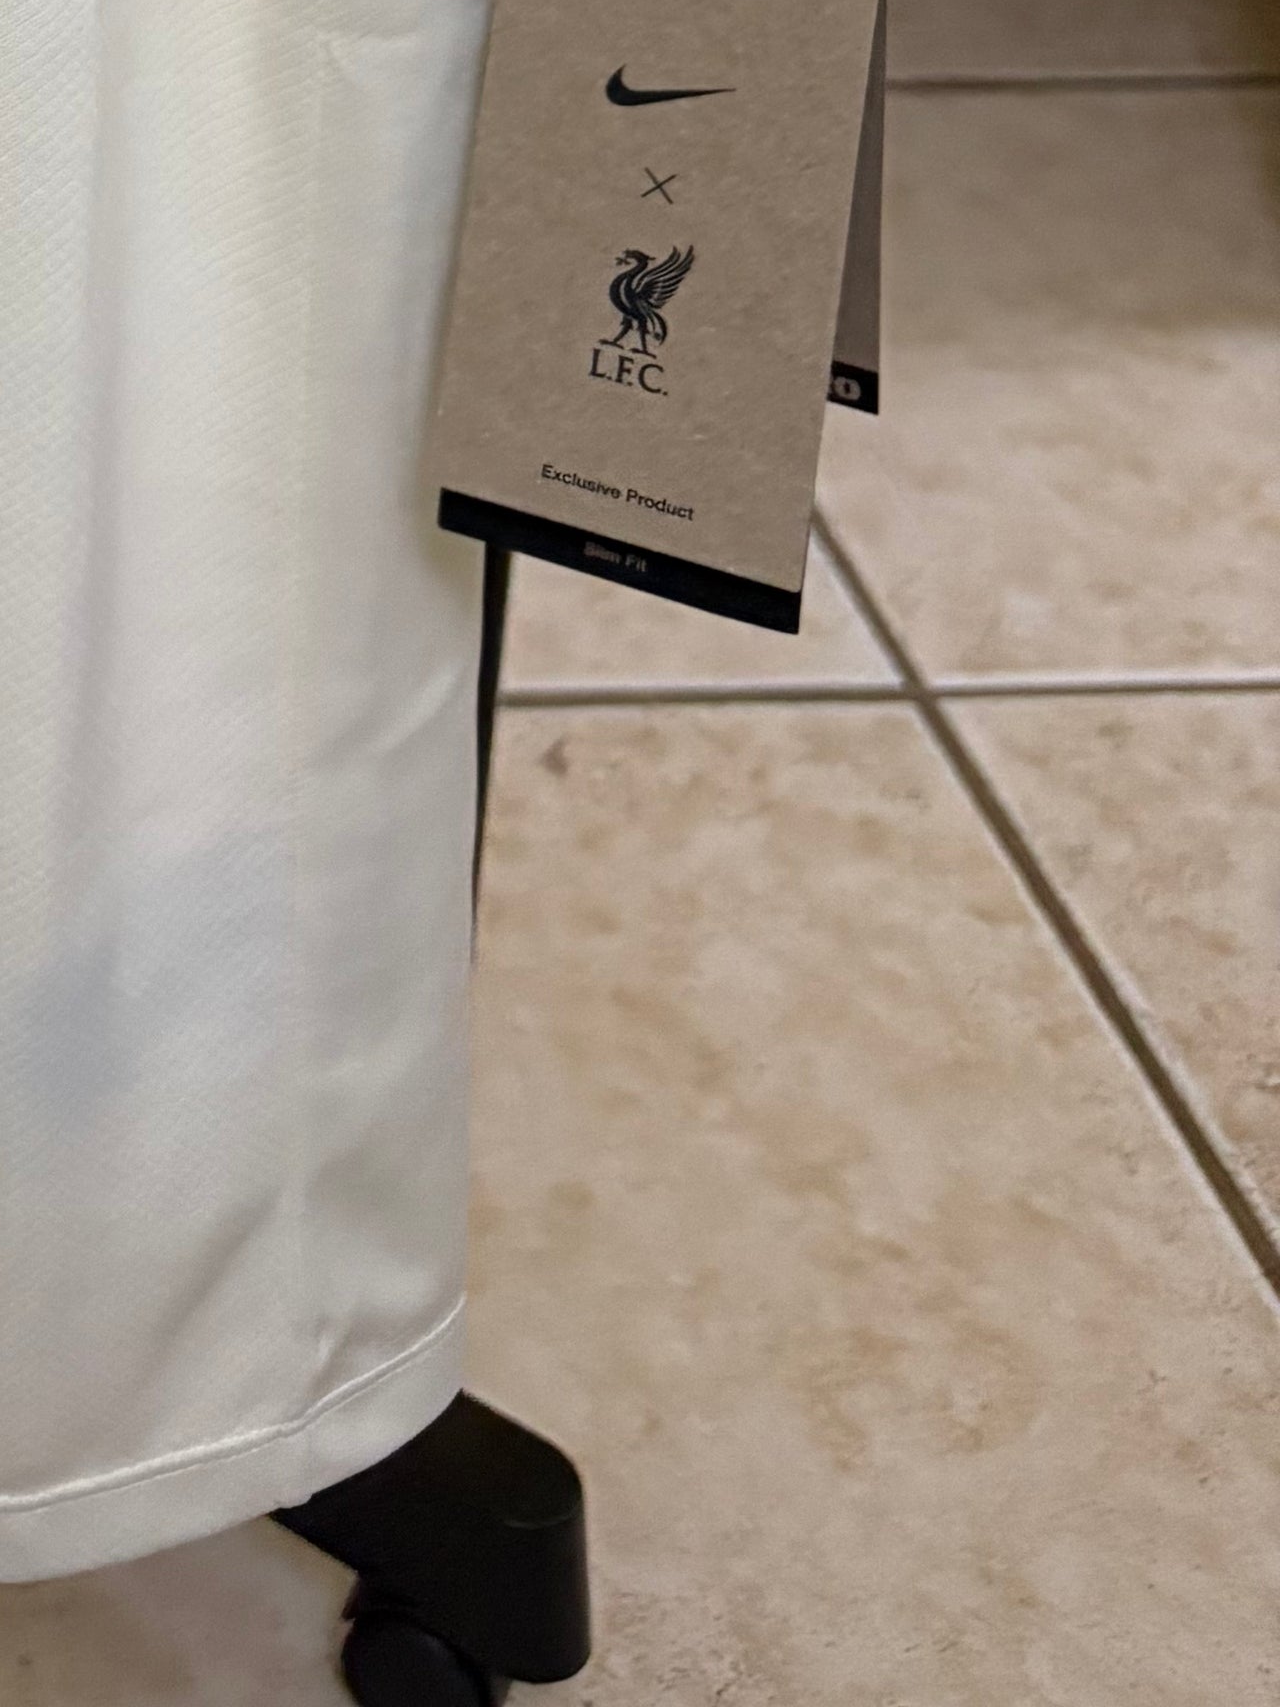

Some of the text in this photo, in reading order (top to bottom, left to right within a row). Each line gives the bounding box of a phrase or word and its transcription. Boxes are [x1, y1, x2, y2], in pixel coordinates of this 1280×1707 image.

[589, 348, 668, 396] L.F.C.
[541, 464, 694, 521] Exclusive Product
[625, 554, 647, 572] Fit
